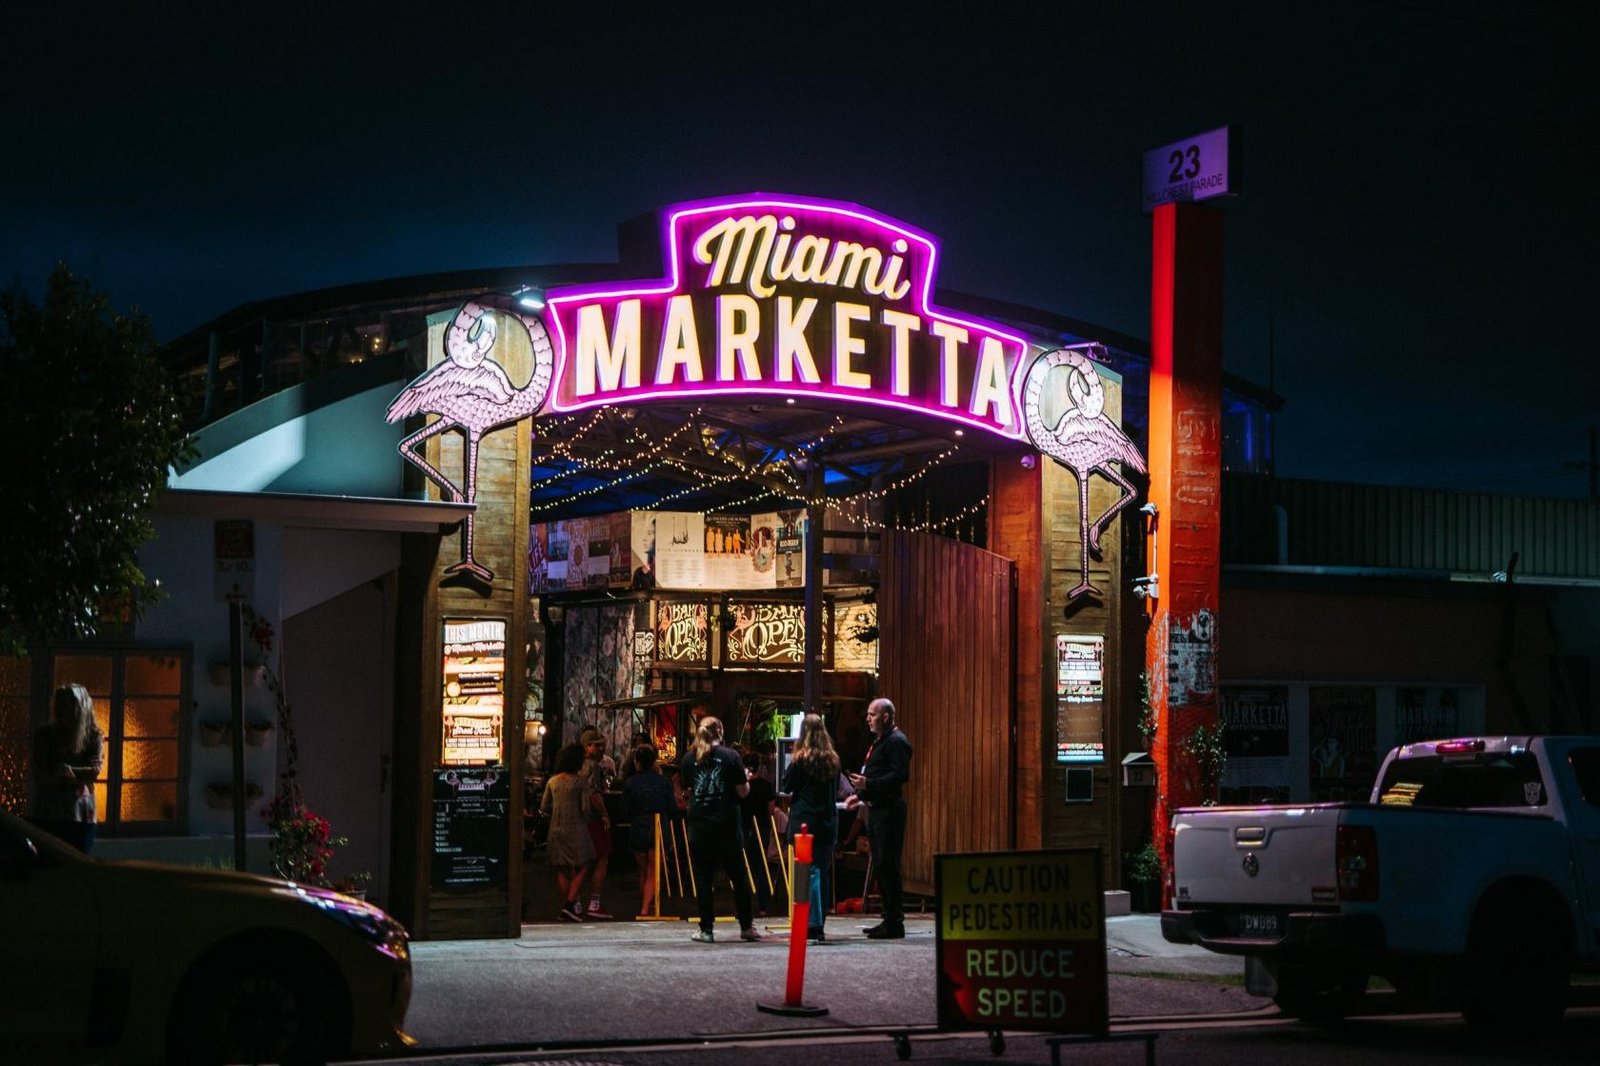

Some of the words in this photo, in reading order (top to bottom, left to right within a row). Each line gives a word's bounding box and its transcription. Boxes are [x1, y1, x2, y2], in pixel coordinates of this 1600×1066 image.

[1168, 145, 1200, 183] 23
[1190, 173, 1223, 191] PARADE
[692, 213, 911, 301] Miami
[575, 293, 1017, 431] MARKETTA
[672, 604, 695, 622] BAR
[754, 605, 799, 622] BAR
[446, 626, 466, 642] THIS
[469, 623, 504, 641] MONTH
[664, 617, 699, 658] OPEN
[743, 618, 805, 659] OPEN
[1221, 698, 1287, 724] MARKETTA
[967, 863, 1070, 894] CAUTION
[949, 901, 1093, 931] PEDESTRIANS
[966, 948, 1075, 979] REDUCE
[977, 987, 1067, 1018] SPEED
